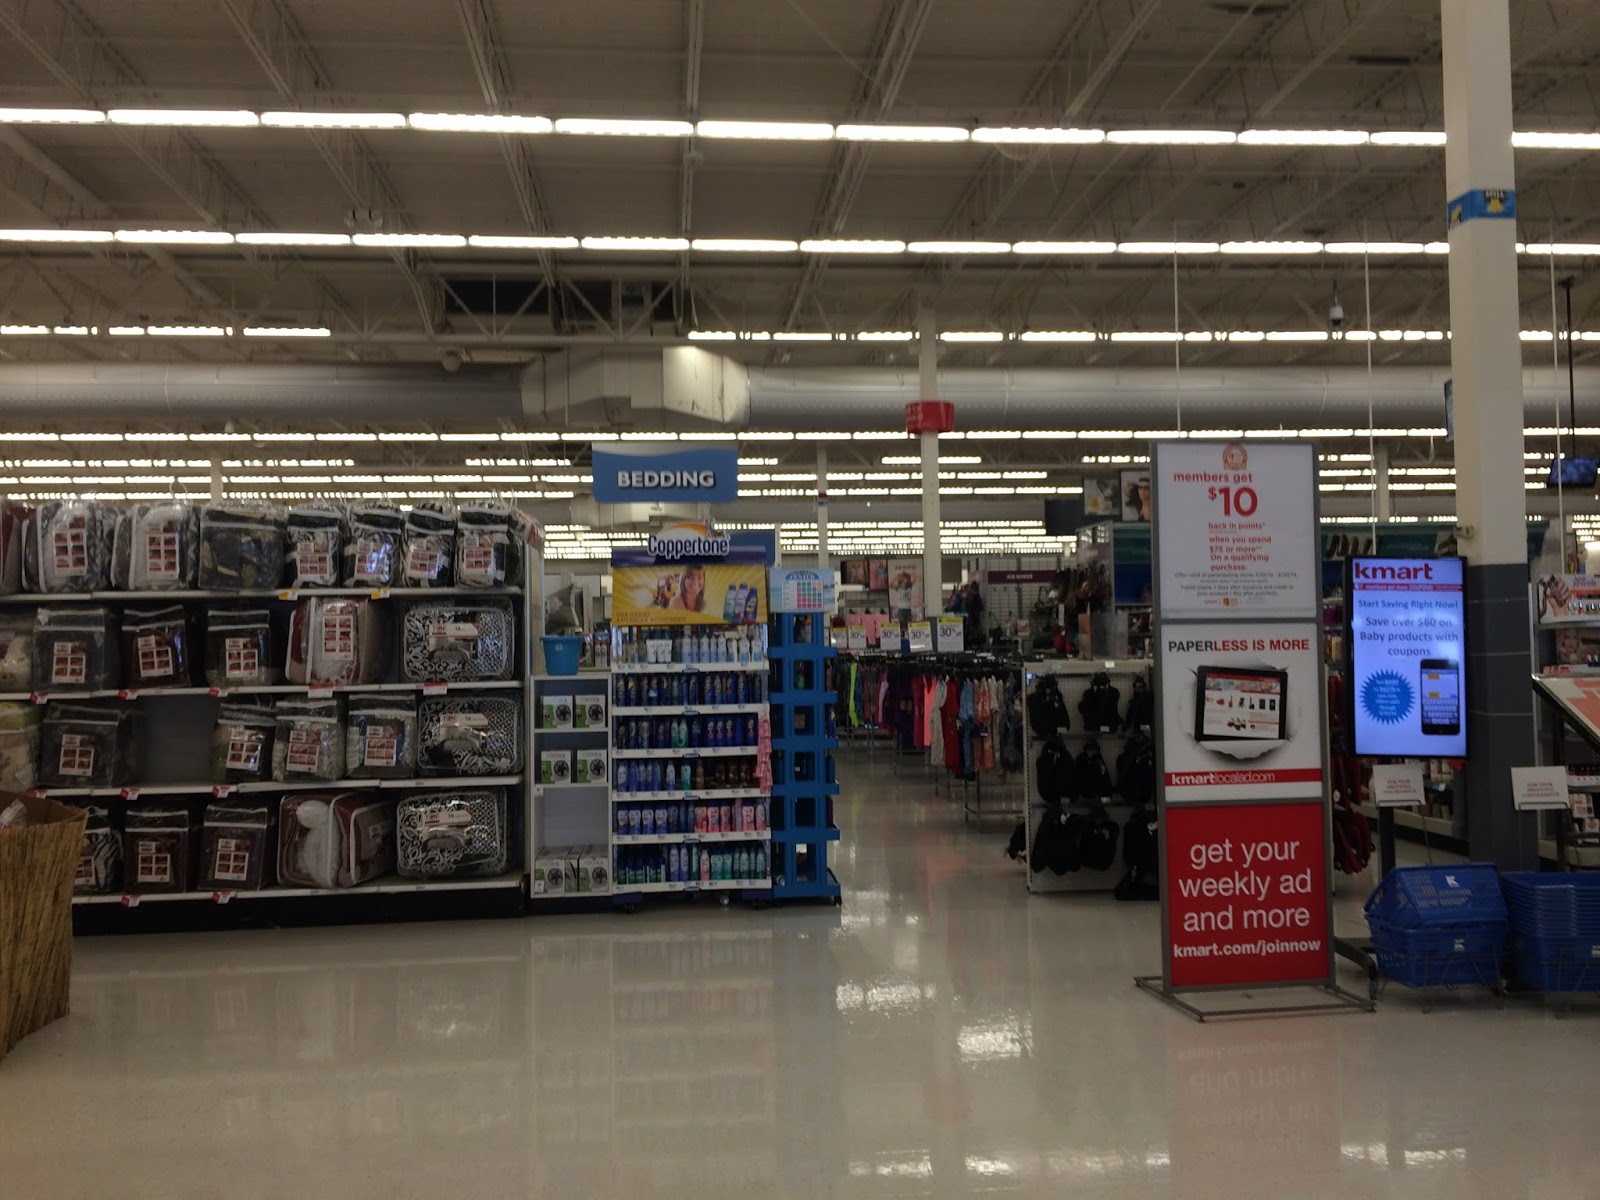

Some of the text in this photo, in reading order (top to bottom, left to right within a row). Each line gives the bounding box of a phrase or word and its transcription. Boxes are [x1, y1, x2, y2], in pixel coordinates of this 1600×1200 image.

[617, 470, 715, 488] BEDDING
[1173, 471, 1253, 484] members get
[1208, 486, 1258, 517] $10
[1208, 522, 1227, 530] back
[1229, 522, 1237, 530] in
[648, 535, 730, 559] Coppertone
[1231, 537, 1247, 545] you
[1248, 536, 1272, 545] spend
[1209, 546, 1224, 554] $75
[1230, 554, 1270, 562] qualifying
[1354, 562, 1433, 580] kmart
[1358, 600, 1458, 609] Start Saving Right Now!
[1365, 617, 1389, 627] Save
[1392, 619, 1414, 627] over
[1360, 631, 1459, 643] Baby products with
[1168, 639, 1310, 652] PAPERLESS IS MORE
[1388, 648, 1431, 656] coupons
[1190, 838, 1300, 870] get your
[1178, 868, 1312, 901] weekly ad
[1183, 905, 1310, 932] and more
[1173, 939, 1321, 958] kmart.com/joinnow
